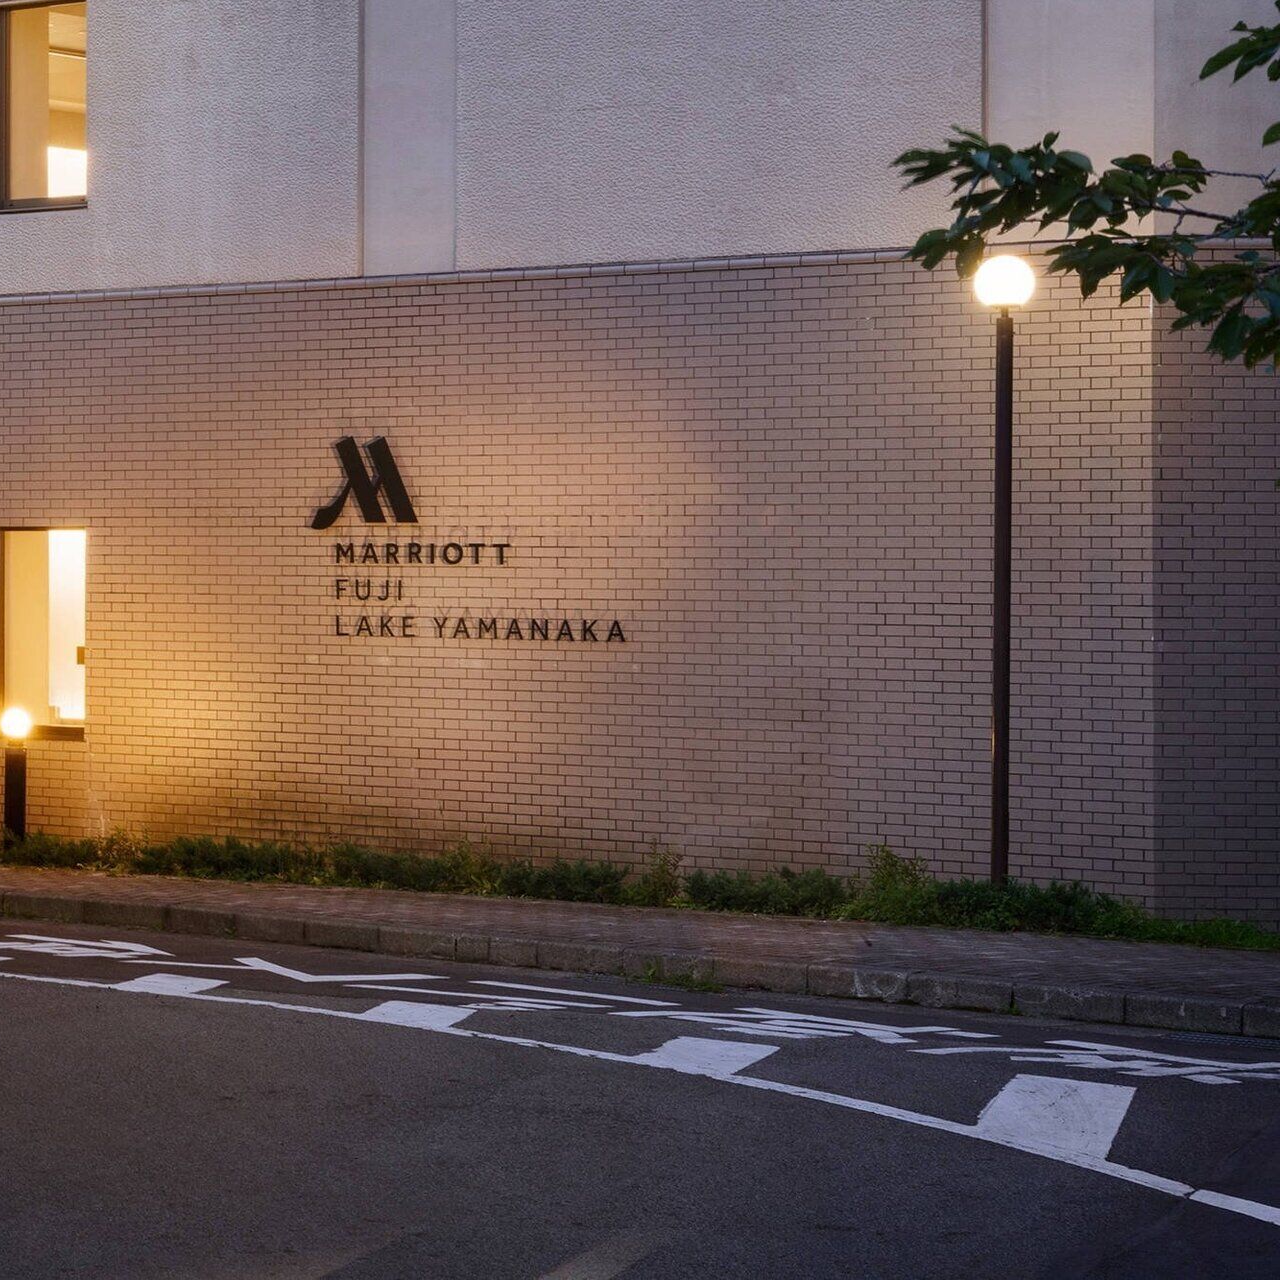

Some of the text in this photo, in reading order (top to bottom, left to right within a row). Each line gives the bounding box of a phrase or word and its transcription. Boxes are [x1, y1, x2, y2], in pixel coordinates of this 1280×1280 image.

[335, 542, 511, 566] MARRIOTT
[335, 578, 403, 601] FUJI
[335, 615, 627, 643] LAKE YAMANAKA
